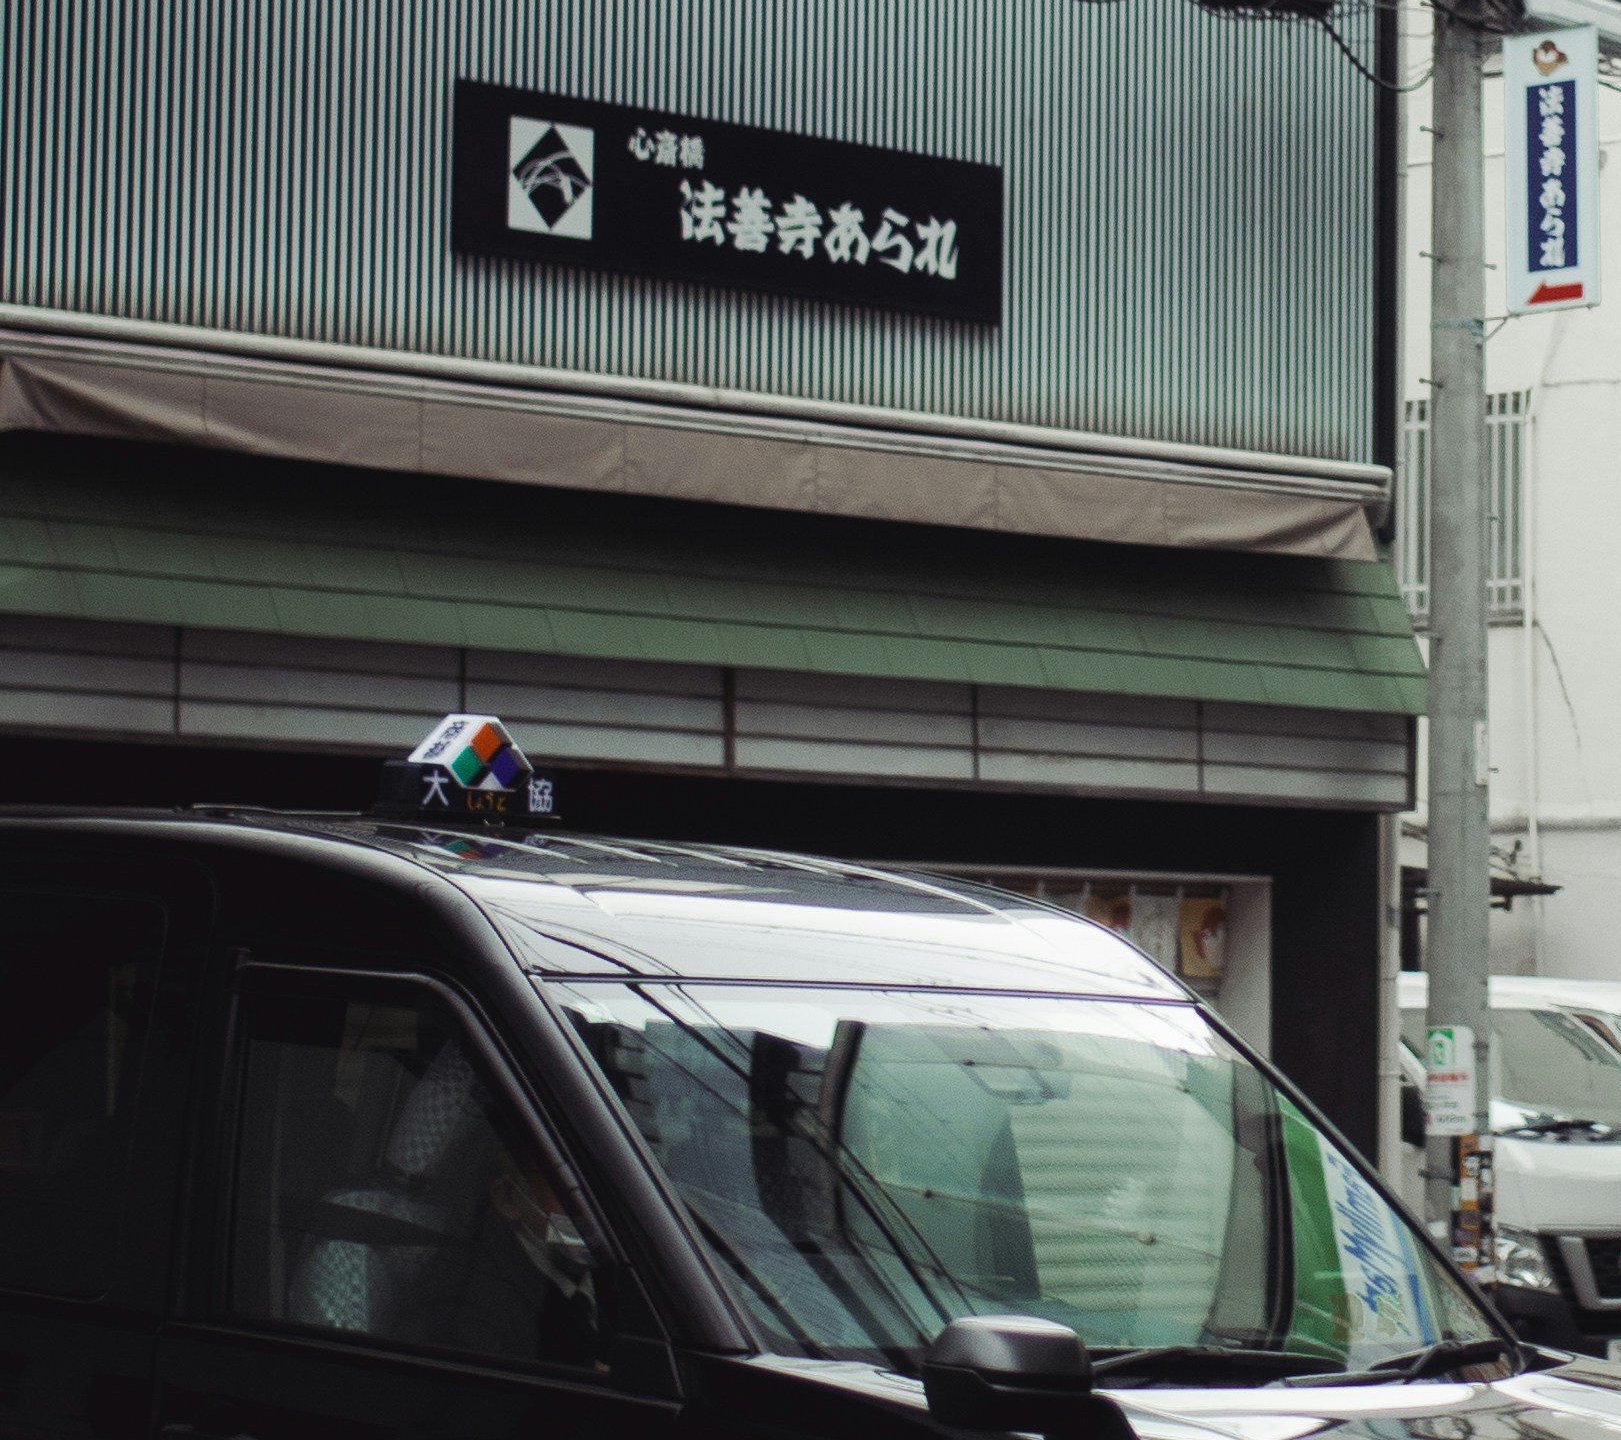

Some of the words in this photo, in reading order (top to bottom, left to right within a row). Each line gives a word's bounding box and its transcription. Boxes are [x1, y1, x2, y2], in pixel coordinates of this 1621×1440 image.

[681, 179, 959, 279] 法善寺あられ
[422, 769, 450, 807] 大
